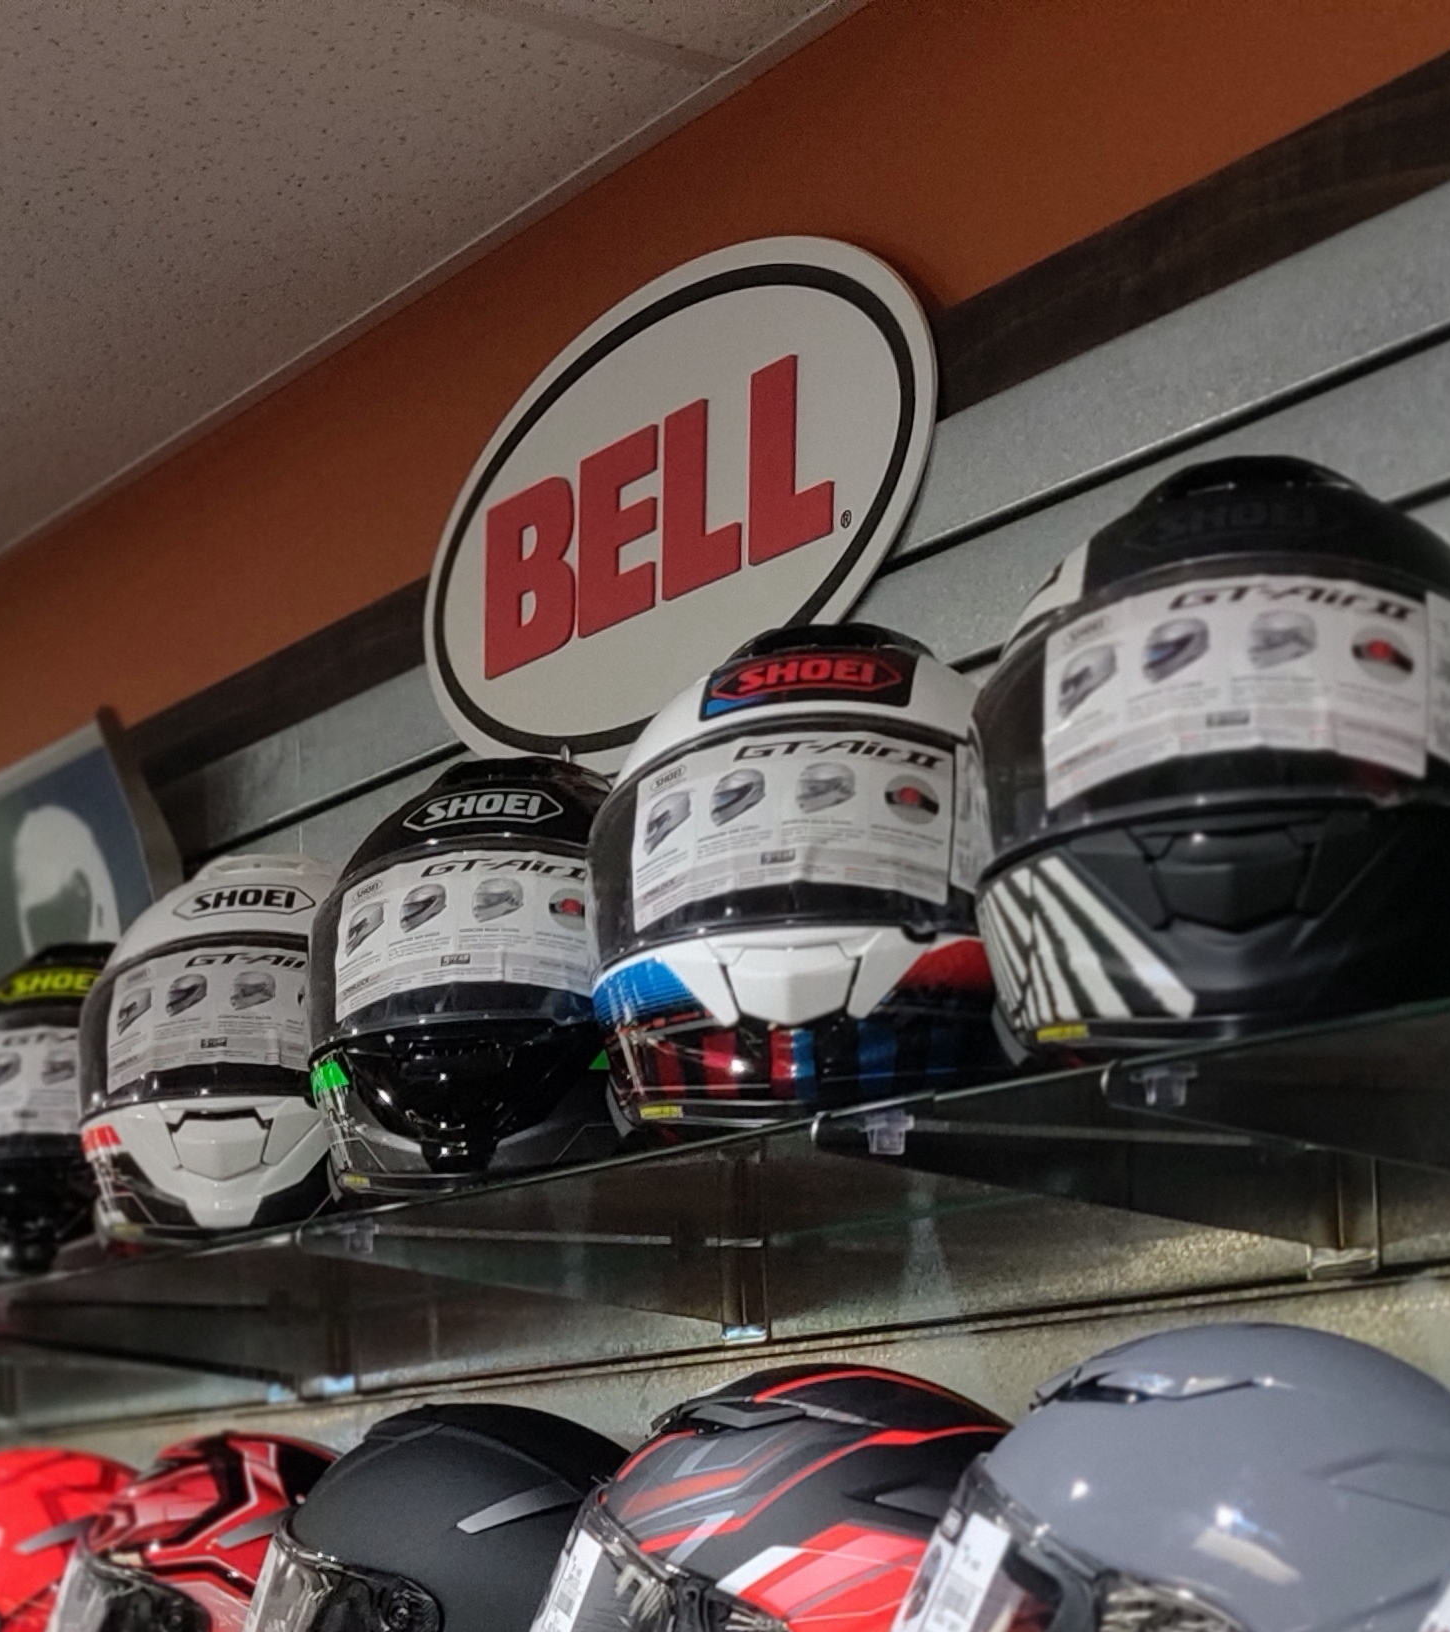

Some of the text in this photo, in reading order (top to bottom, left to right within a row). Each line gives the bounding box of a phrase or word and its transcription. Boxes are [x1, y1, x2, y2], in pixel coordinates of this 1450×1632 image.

[485, 354, 834, 681] BELL
[738, 657, 875, 691] SHOEI
[733, 740, 945, 770] GT-Air II
[424, 793, 542, 821] SHOEI
[421, 856, 565, 878] GT-Air
[193, 884, 296, 910] SHOEI
[13, 971, 97, 994] SHOE
